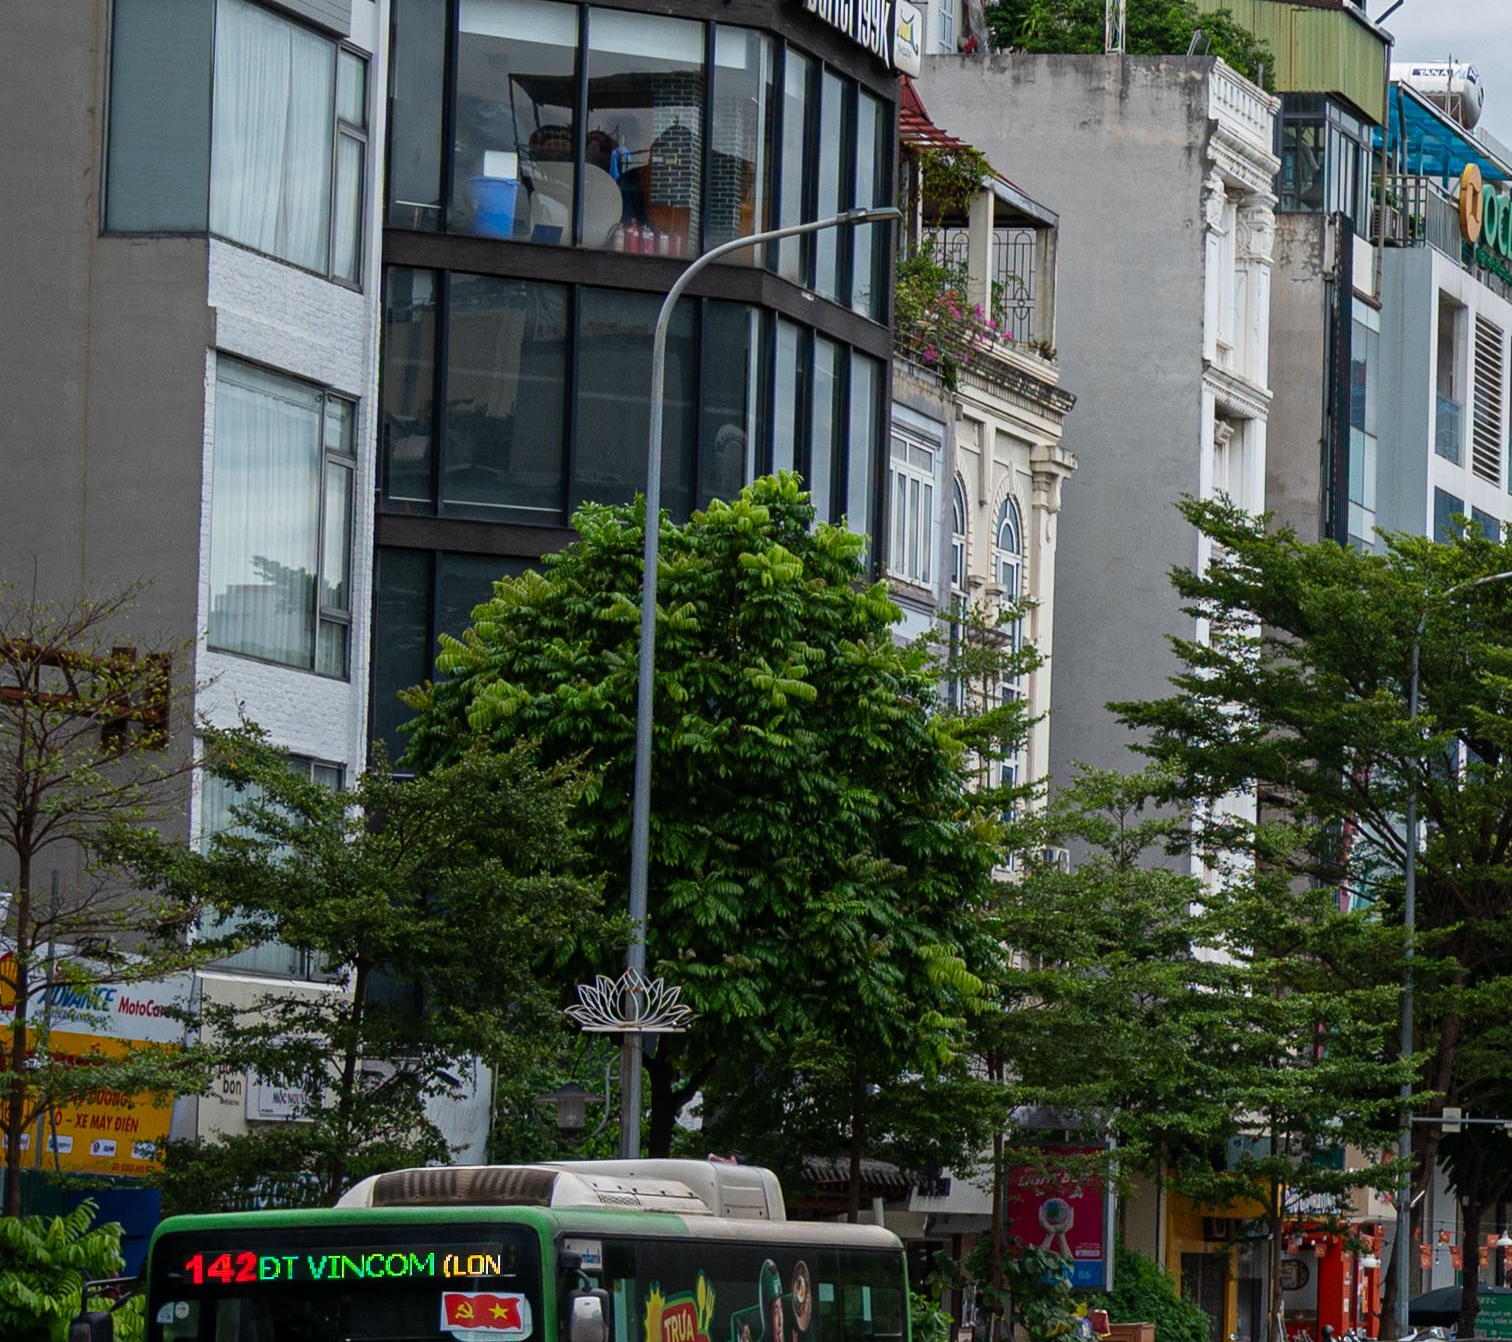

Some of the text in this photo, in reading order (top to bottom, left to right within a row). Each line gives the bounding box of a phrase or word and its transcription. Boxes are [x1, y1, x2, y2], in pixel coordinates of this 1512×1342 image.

[74, 1113, 88, 1129] XE
[90, 1113, 113, 1131] MÁY
[114, 1117, 139, 1137] ĐIỆN
[186, 1252, 258, 1285] 142
[307, 1253, 436, 1280] VINCOM
[443, 1253, 502, 1278] (LON
